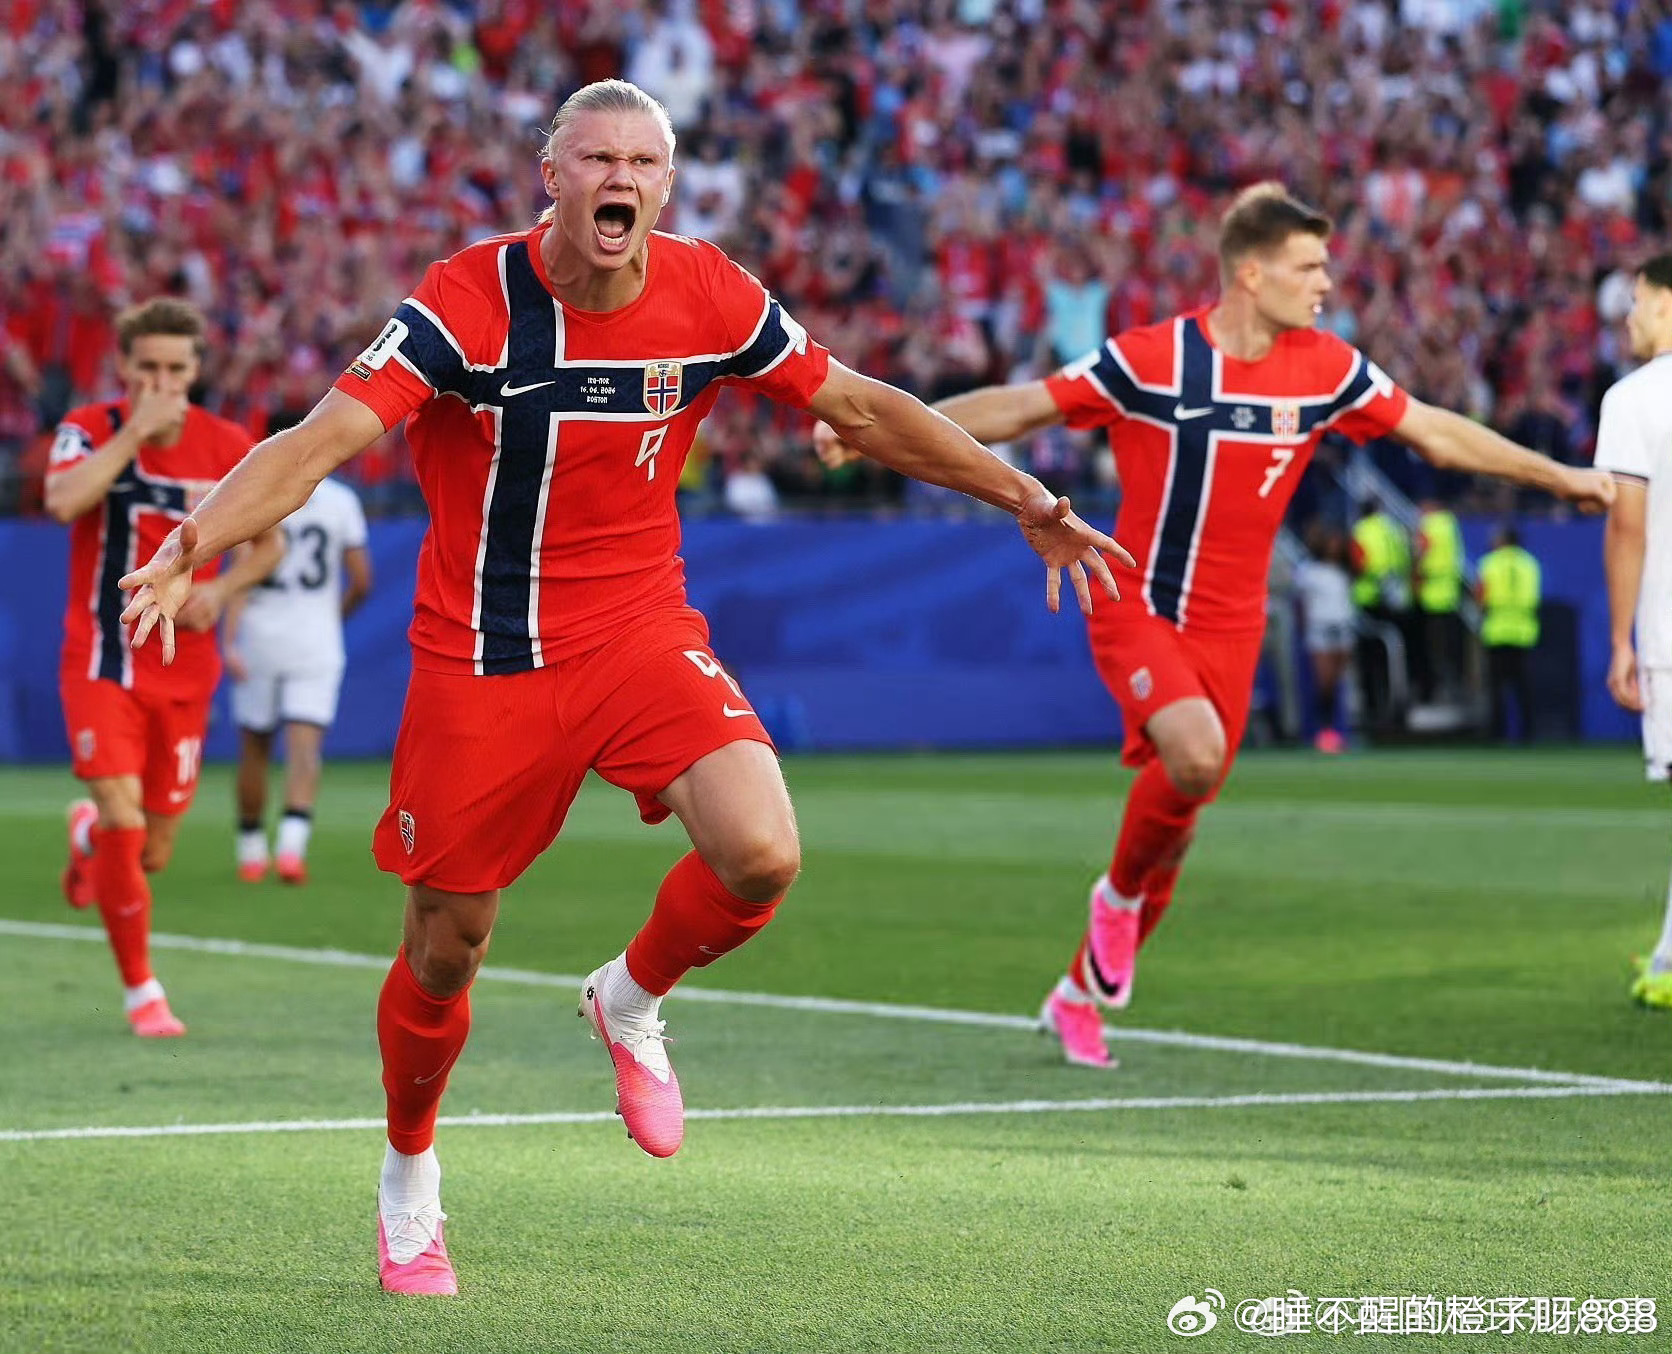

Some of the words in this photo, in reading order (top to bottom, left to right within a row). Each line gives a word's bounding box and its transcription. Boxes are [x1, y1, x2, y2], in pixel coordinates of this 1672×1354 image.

[586, 395, 608, 404] BOSTON
[634, 423, 669, 482] 9
[1258, 447, 1295, 498] 7
[682, 650, 743, 699] 9
